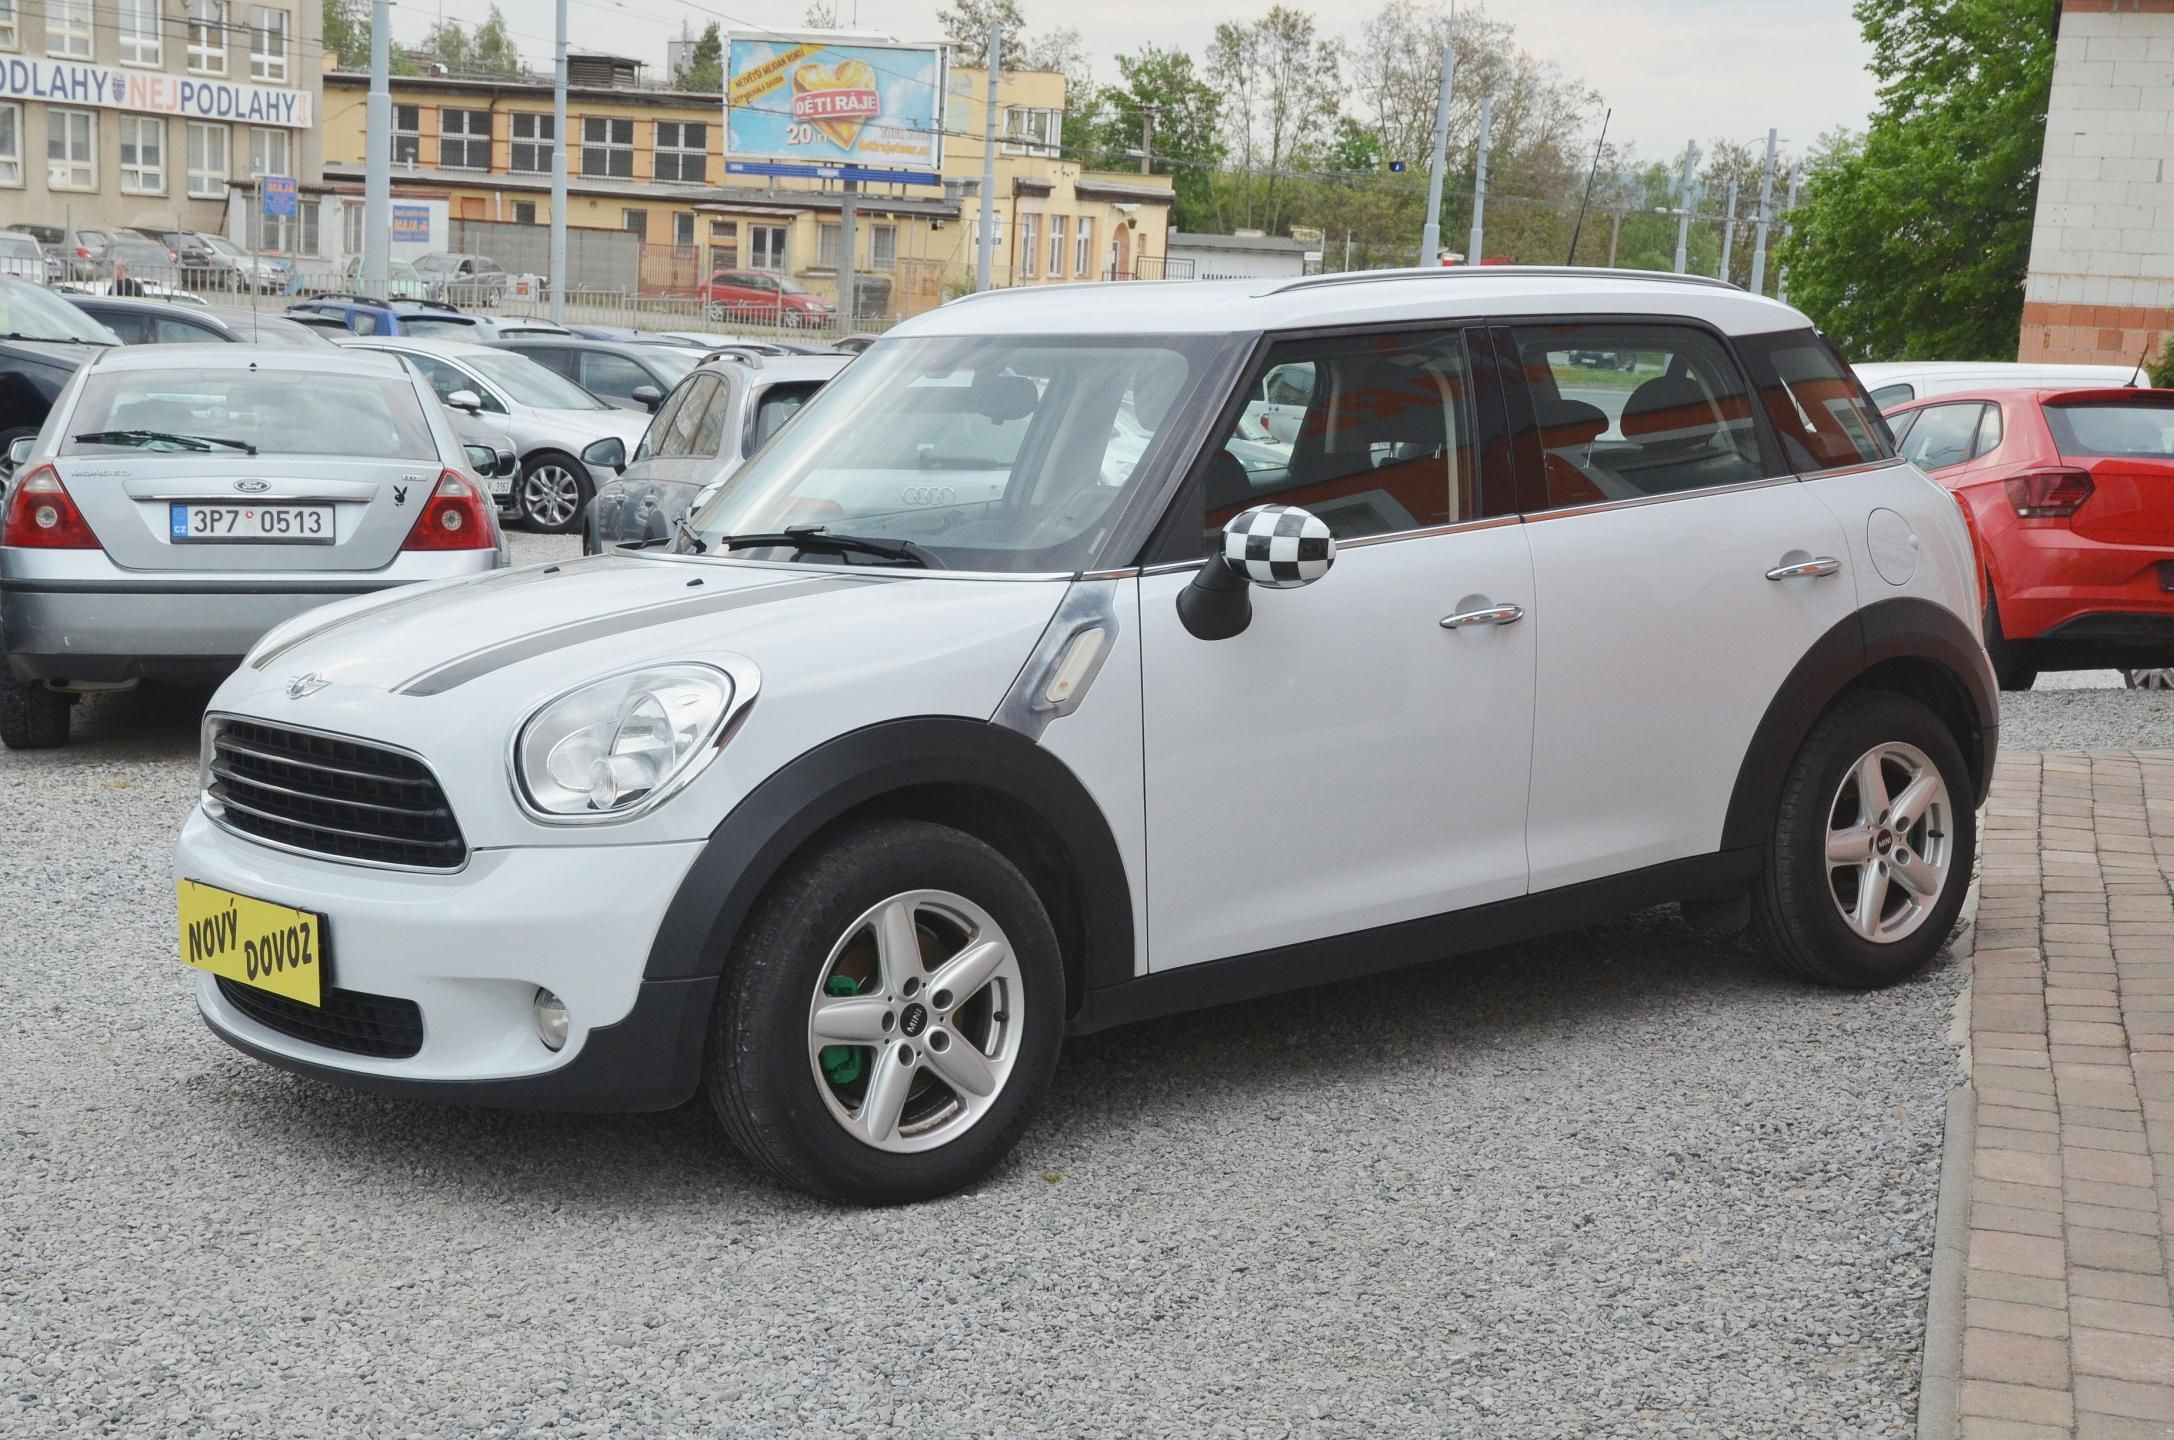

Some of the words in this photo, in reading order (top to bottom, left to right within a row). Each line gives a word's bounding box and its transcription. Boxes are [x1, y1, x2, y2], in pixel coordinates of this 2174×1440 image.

[796, 95, 832, 115] DĚTI
[835, 92, 876, 112] RÁJE
[787, 124, 812, 144] 20
[194, 509, 239, 534] 3P7
[260, 510, 322, 534] 0513
[188, 896, 237, 963] NOVÝ
[244, 921, 312, 981] DOVOZ
[906, 1008, 922, 1033] MINI
